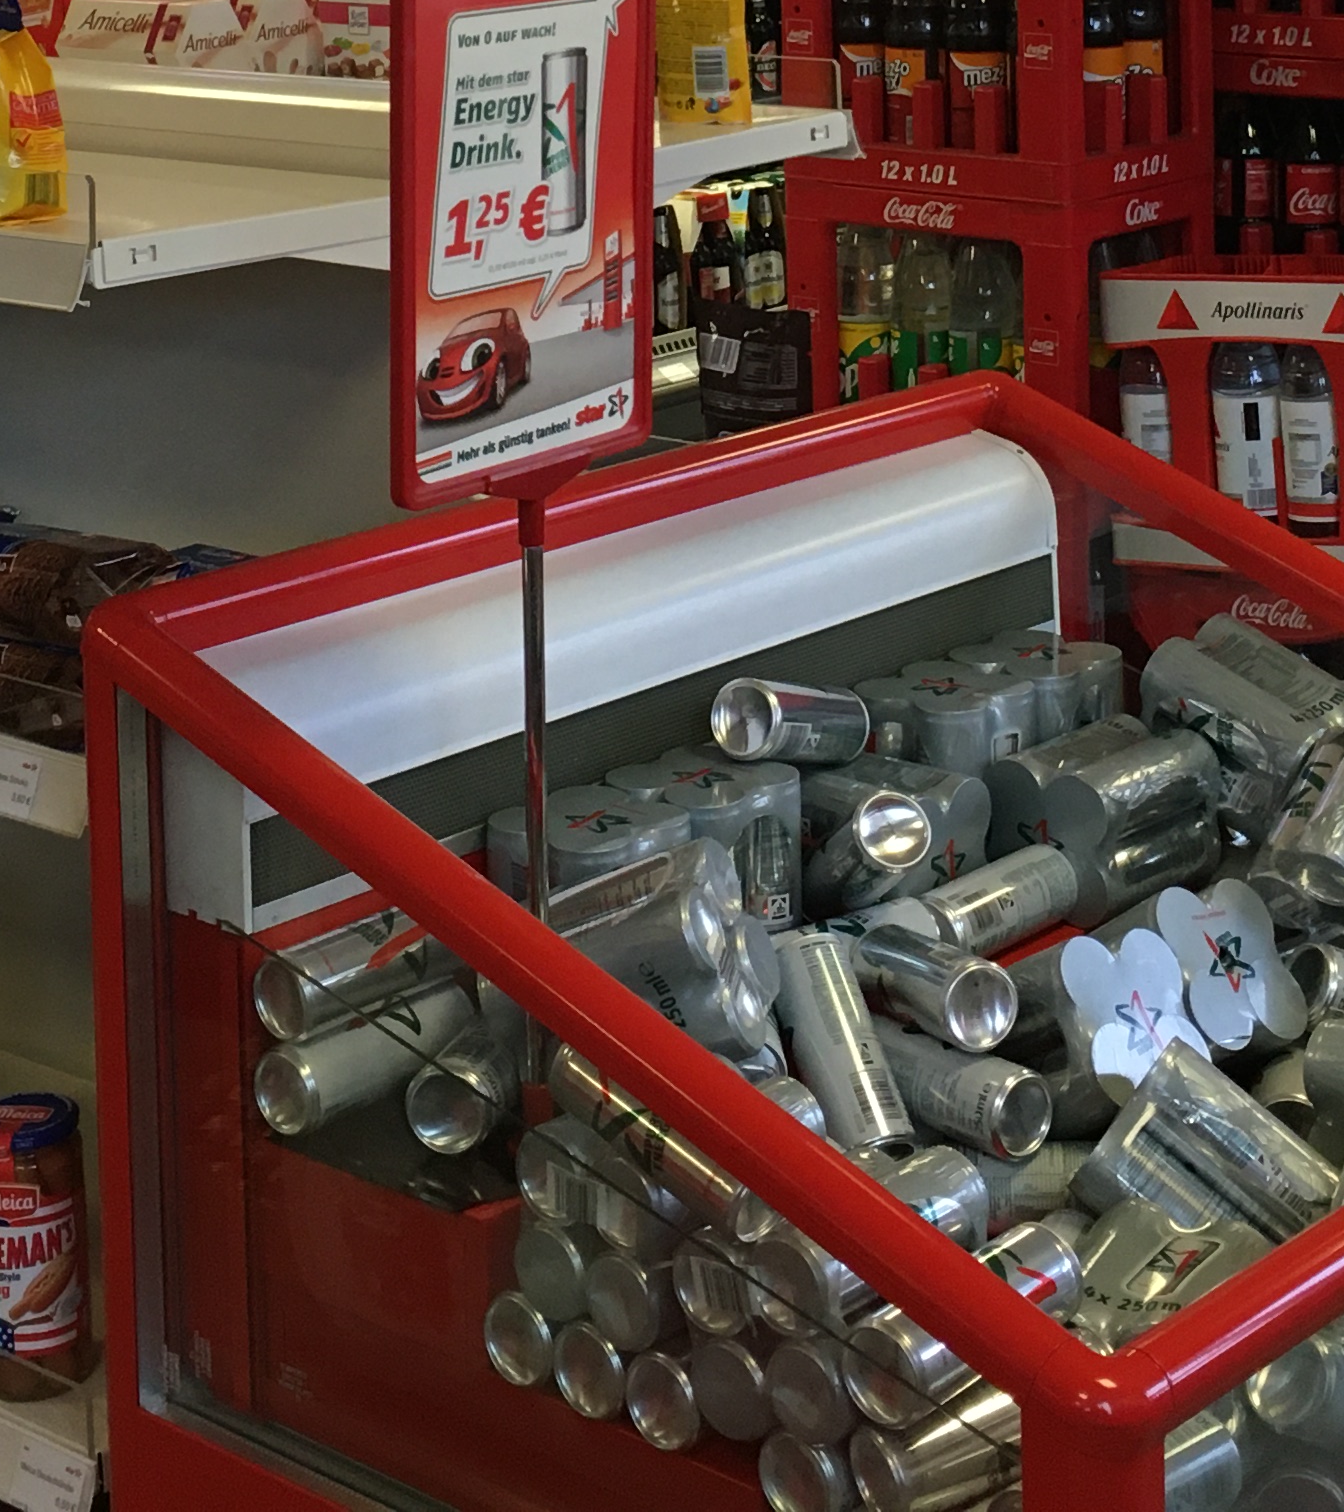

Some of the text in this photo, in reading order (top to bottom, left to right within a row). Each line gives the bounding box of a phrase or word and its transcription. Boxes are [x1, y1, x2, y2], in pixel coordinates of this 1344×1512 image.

[78, 7, 154, 35] Amicelli
[256, 19, 309, 43] Amicelli
[1230, 24, 1249, 44] 12
[1271, 24, 1299, 46] 1.0
[182, 31, 239, 54] Amicelli
[455, 69, 530, 92] Mit dem star
[1250, 58, 1301, 88] Coke
[453, 90, 536, 128] Energy
[449, 132, 523, 171] Drink.
[881, 159, 898, 179] 12
[918, 163, 943, 183] 1.0
[1113, 162, 1126, 182] 12
[1141, 156, 1159, 177] 1.0
[518, 184, 551, 241] €
[883, 196, 957, 230] Coca-Cola
[1125, 198, 1160, 226] Coke
[1210, 300, 1307, 322] Apollinaris
[457, 403, 607, 464] Mehr als günstig tanken! star
[1231, 594, 1314, 631] Coca-Cola
[1117, 1298, 1158, 1312] 250
